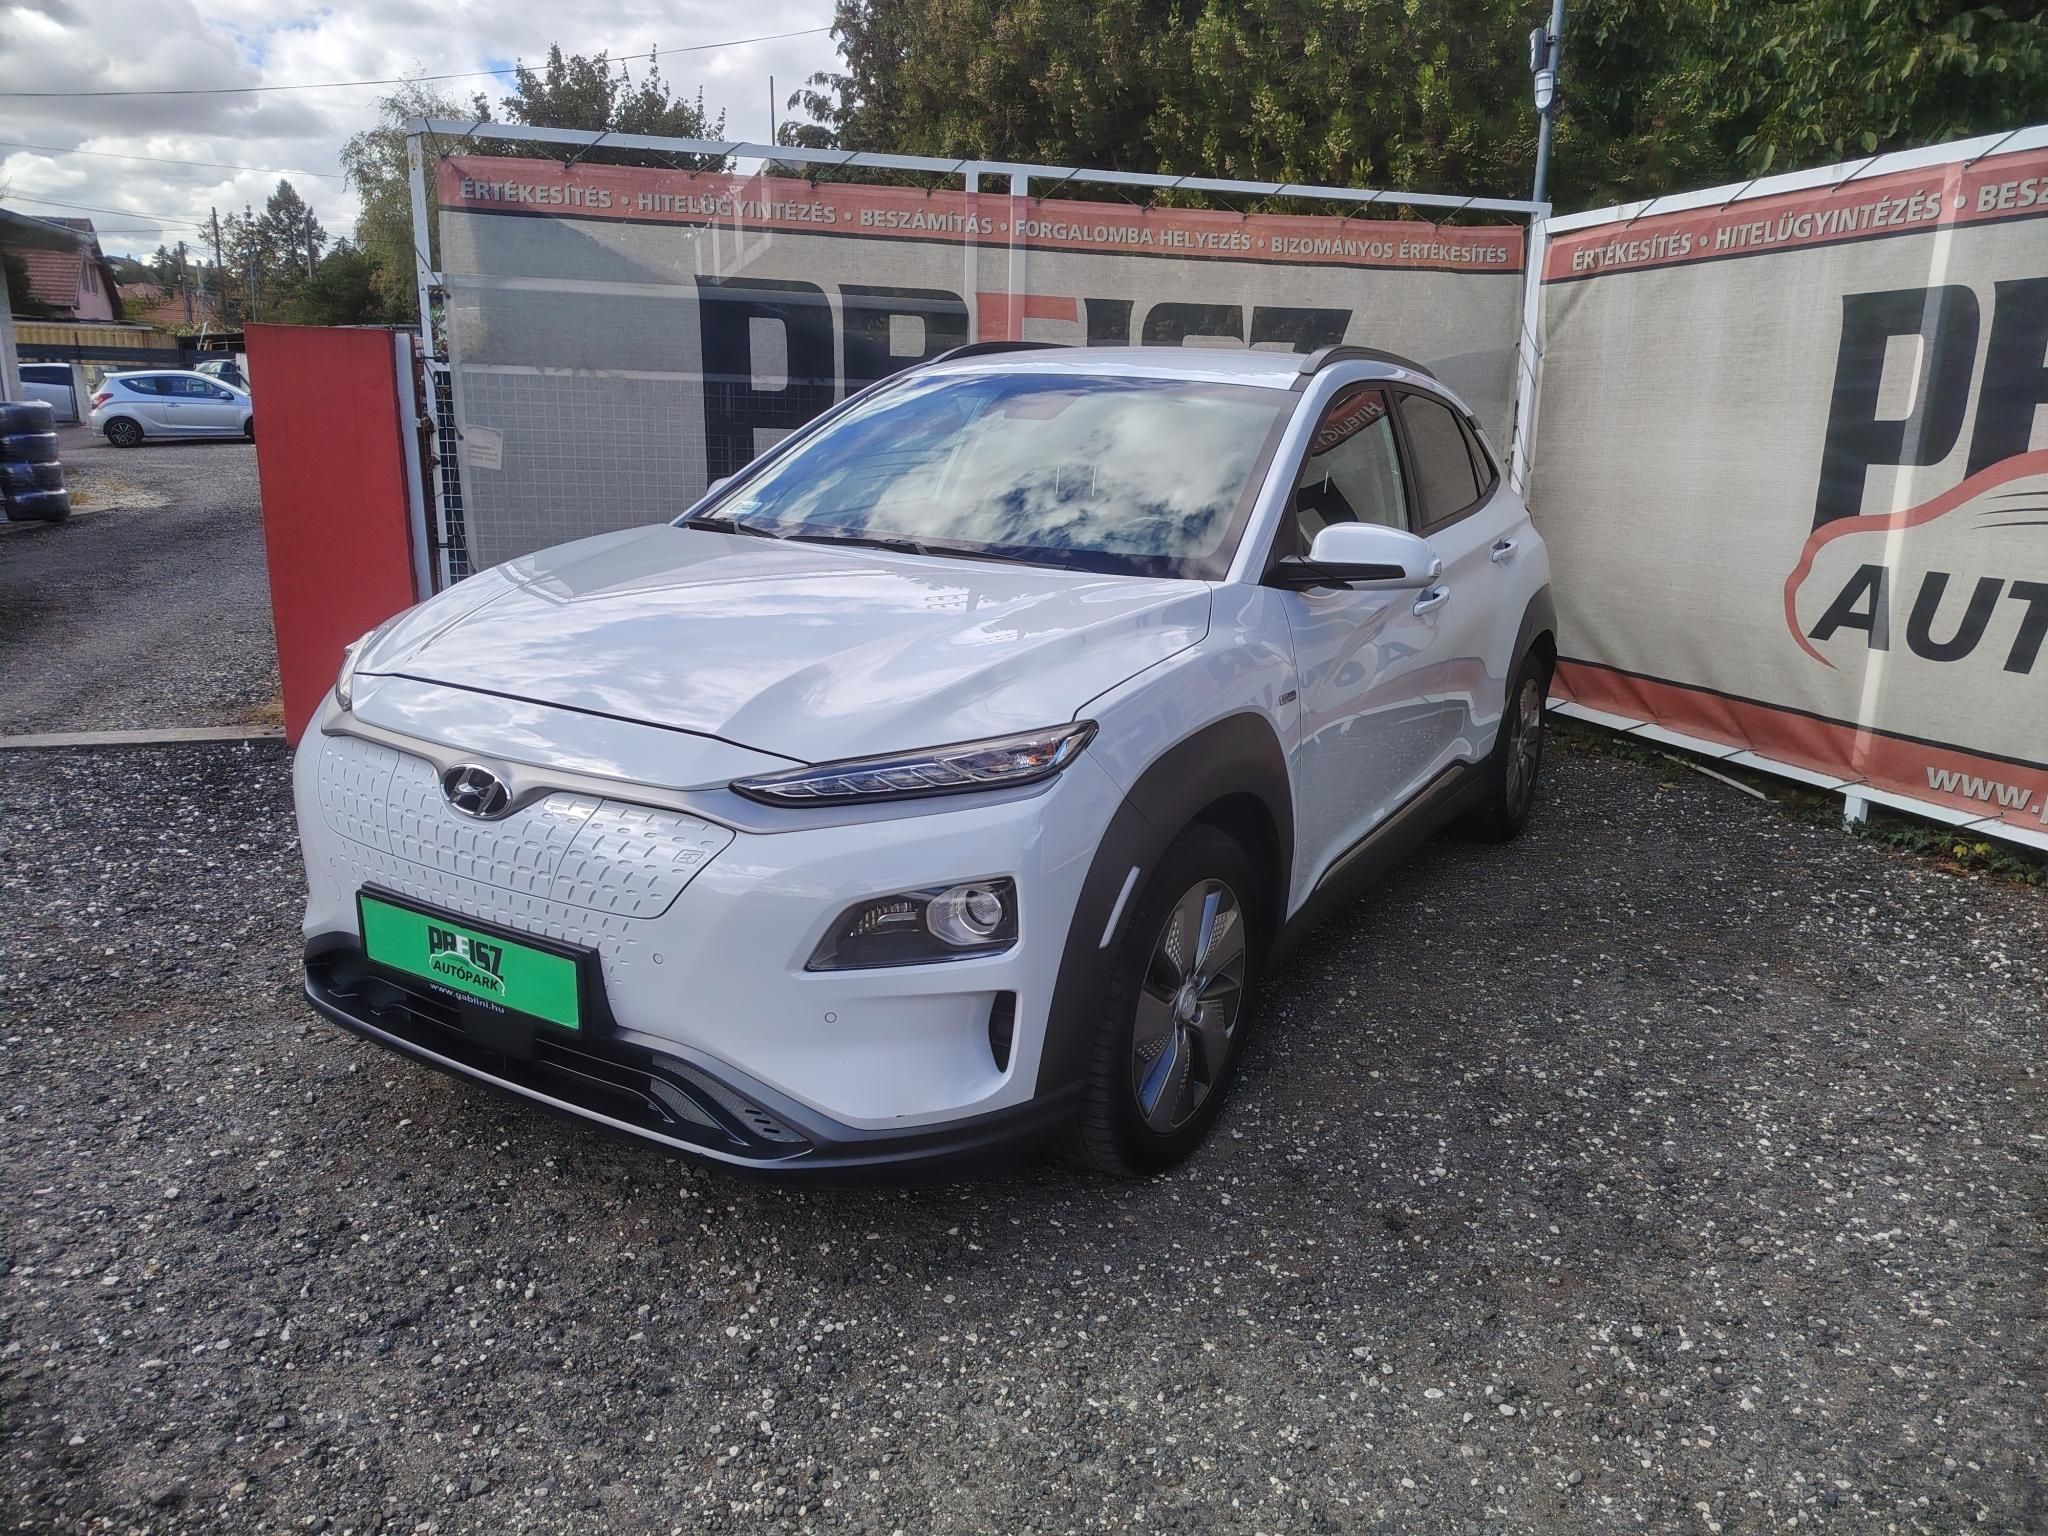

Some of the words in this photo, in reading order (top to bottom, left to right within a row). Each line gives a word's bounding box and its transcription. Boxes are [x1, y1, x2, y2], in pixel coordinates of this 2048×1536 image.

[461, 177, 612, 208] ÉRTÉKESÍTÉS
[638, 192, 836, 224] HITELÜGYINTÉZÉS
[860, 208, 993, 235] BESZÁMÍTÁS
[1015, 219, 1153, 245] FORGALOMBA
[1159, 230, 1252, 250] HELYEZÉS
[1271, 235, 1394, 259] BIZOMÁNYOS
[1400, 240, 1507, 263] ÉRTÉKESÍTÉS
[1572, 230, 1692, 272] ÉRTÉKESÍTÉS
[1715, 189, 1942, 250] HITELÜGYINTÉZÉS
[1926, 766, 2048, 825] www.
[428, 925, 504, 982] PREISZ
[433, 960, 498, 991] AUTÓPARK
[429, 983, 505, 1013] www.gablini.hu
